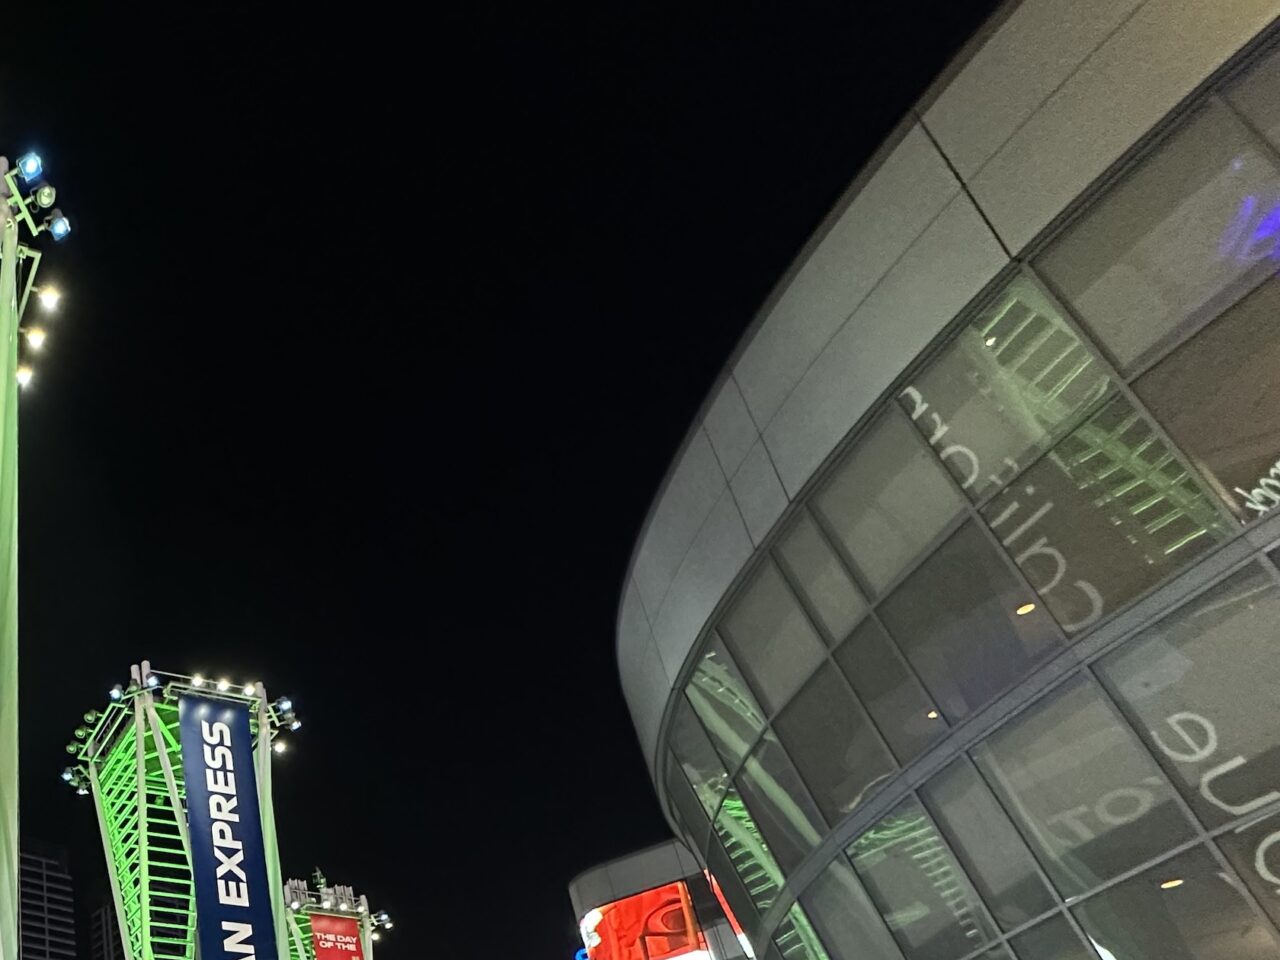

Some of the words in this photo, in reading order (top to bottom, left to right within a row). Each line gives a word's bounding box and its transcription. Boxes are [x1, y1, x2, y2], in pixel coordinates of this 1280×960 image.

[200, 719, 251, 908] EXPRESS
[315, 932, 336, 942] THE
[336, 935, 357, 943] DAY
[319, 941, 334, 949] OF
[335, 943, 357, 951] THE
